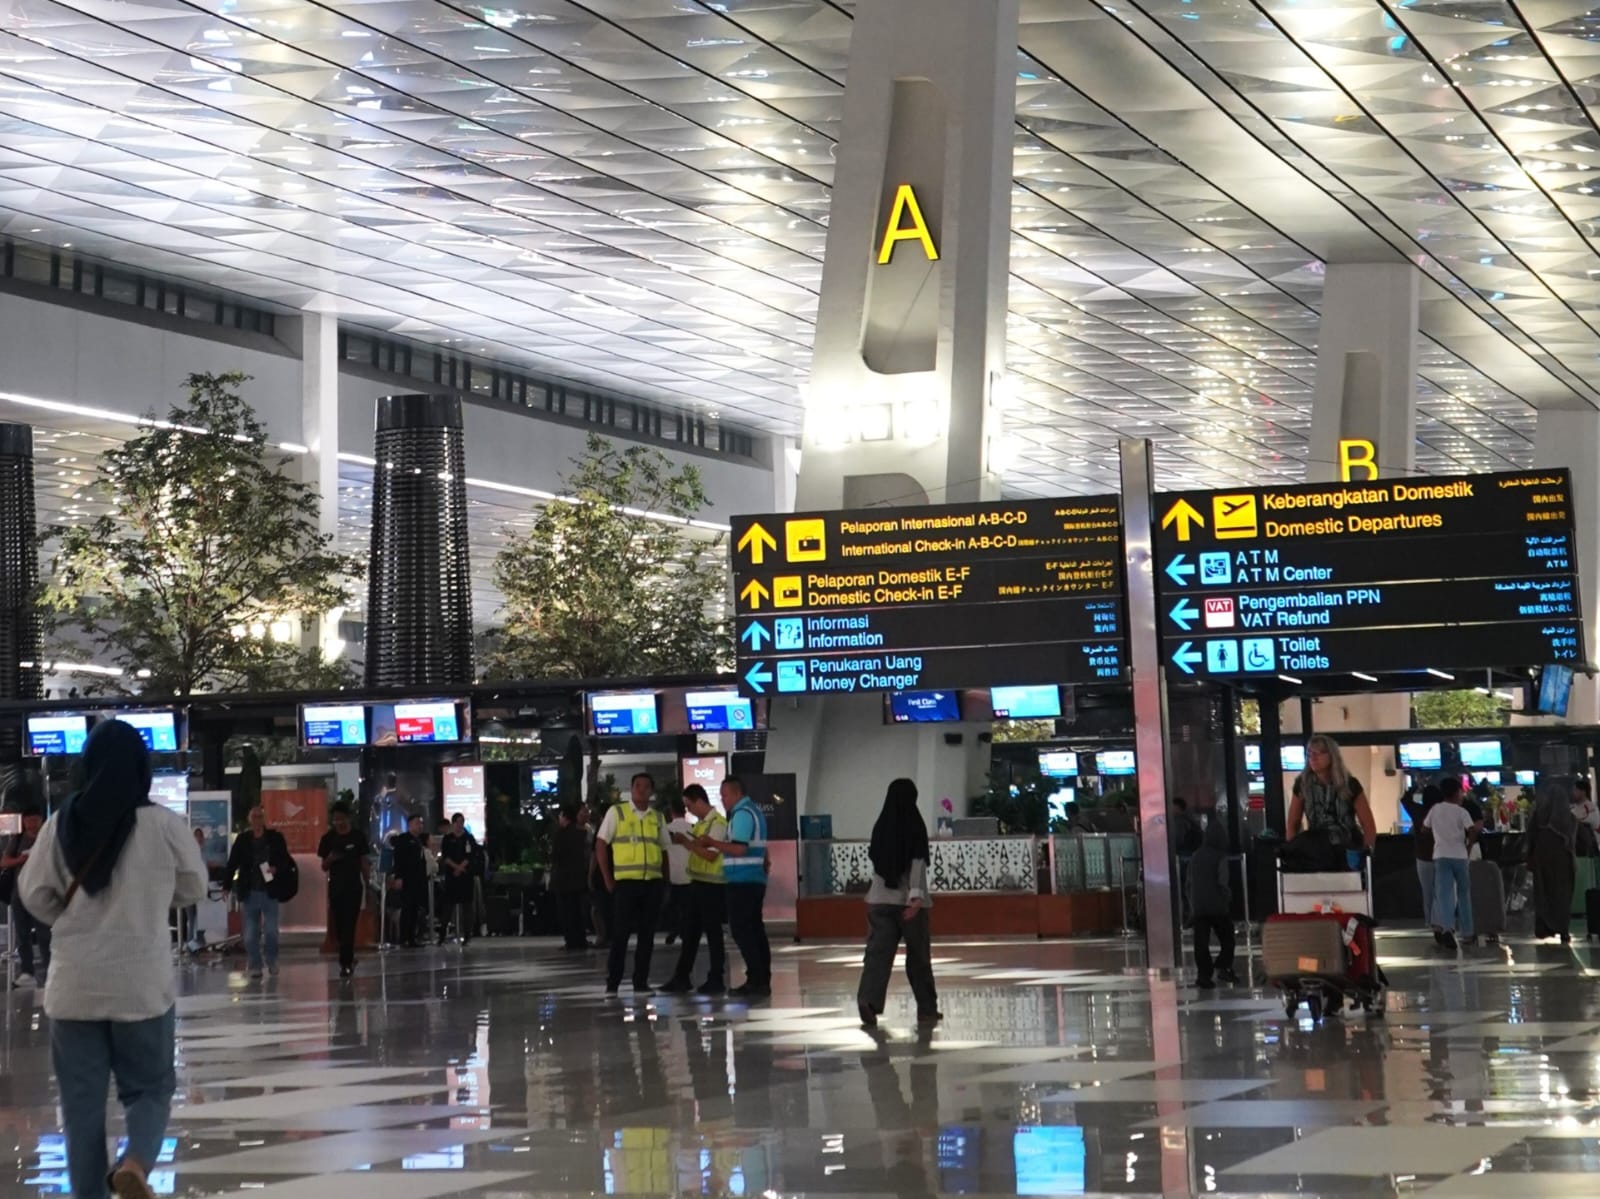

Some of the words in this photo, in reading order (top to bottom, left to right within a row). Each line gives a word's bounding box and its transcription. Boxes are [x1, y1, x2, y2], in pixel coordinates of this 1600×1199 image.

[878, 184, 939, 265] A
[1339, 440, 1379, 482] B
[1263, 487, 1391, 510] Keberangkatan
[1395, 482, 1473, 502] Domestik
[841, 520, 899, 535] Pelaporan
[901, 515, 976, 530] Internasional
[978, 512, 1027, 526] A-B-C-D
[1266, 518, 1344, 537] Domestic
[1348, 514, 1442, 534] Departures
[842, 541, 911, 557] International
[914, 538, 966, 553] Check-in
[969, 535, 1016, 550] A-B-C-D
[808, 573, 874, 589] Pelaporan
[879, 569, 942, 584] Domestik
[946, 567, 970, 581] E-F
[1284, 566, 1332, 581] Center
[809, 591, 871, 606] Domestic
[874, 588, 934, 602] Check-in
[939, 585, 963, 599] E-F
[1239, 592, 1343, 610] Pengembalian
[1346, 589, 1381, 605] PPN
[1208, 601, 1230, 611] VAT
[808, 615, 869, 631] Informasi
[1241, 612, 1272, 628] VAT
[1277, 610, 1329, 625] Refund
[808, 633, 883, 648] Information
[1279, 638, 1320, 652] Toilet
[810, 659, 881, 674] Penukaran
[885, 655, 922, 672] Uang
[1280, 655, 1329, 670] Toilets
[811, 676, 856, 693] Money
[859, 673, 918, 689] Changer
